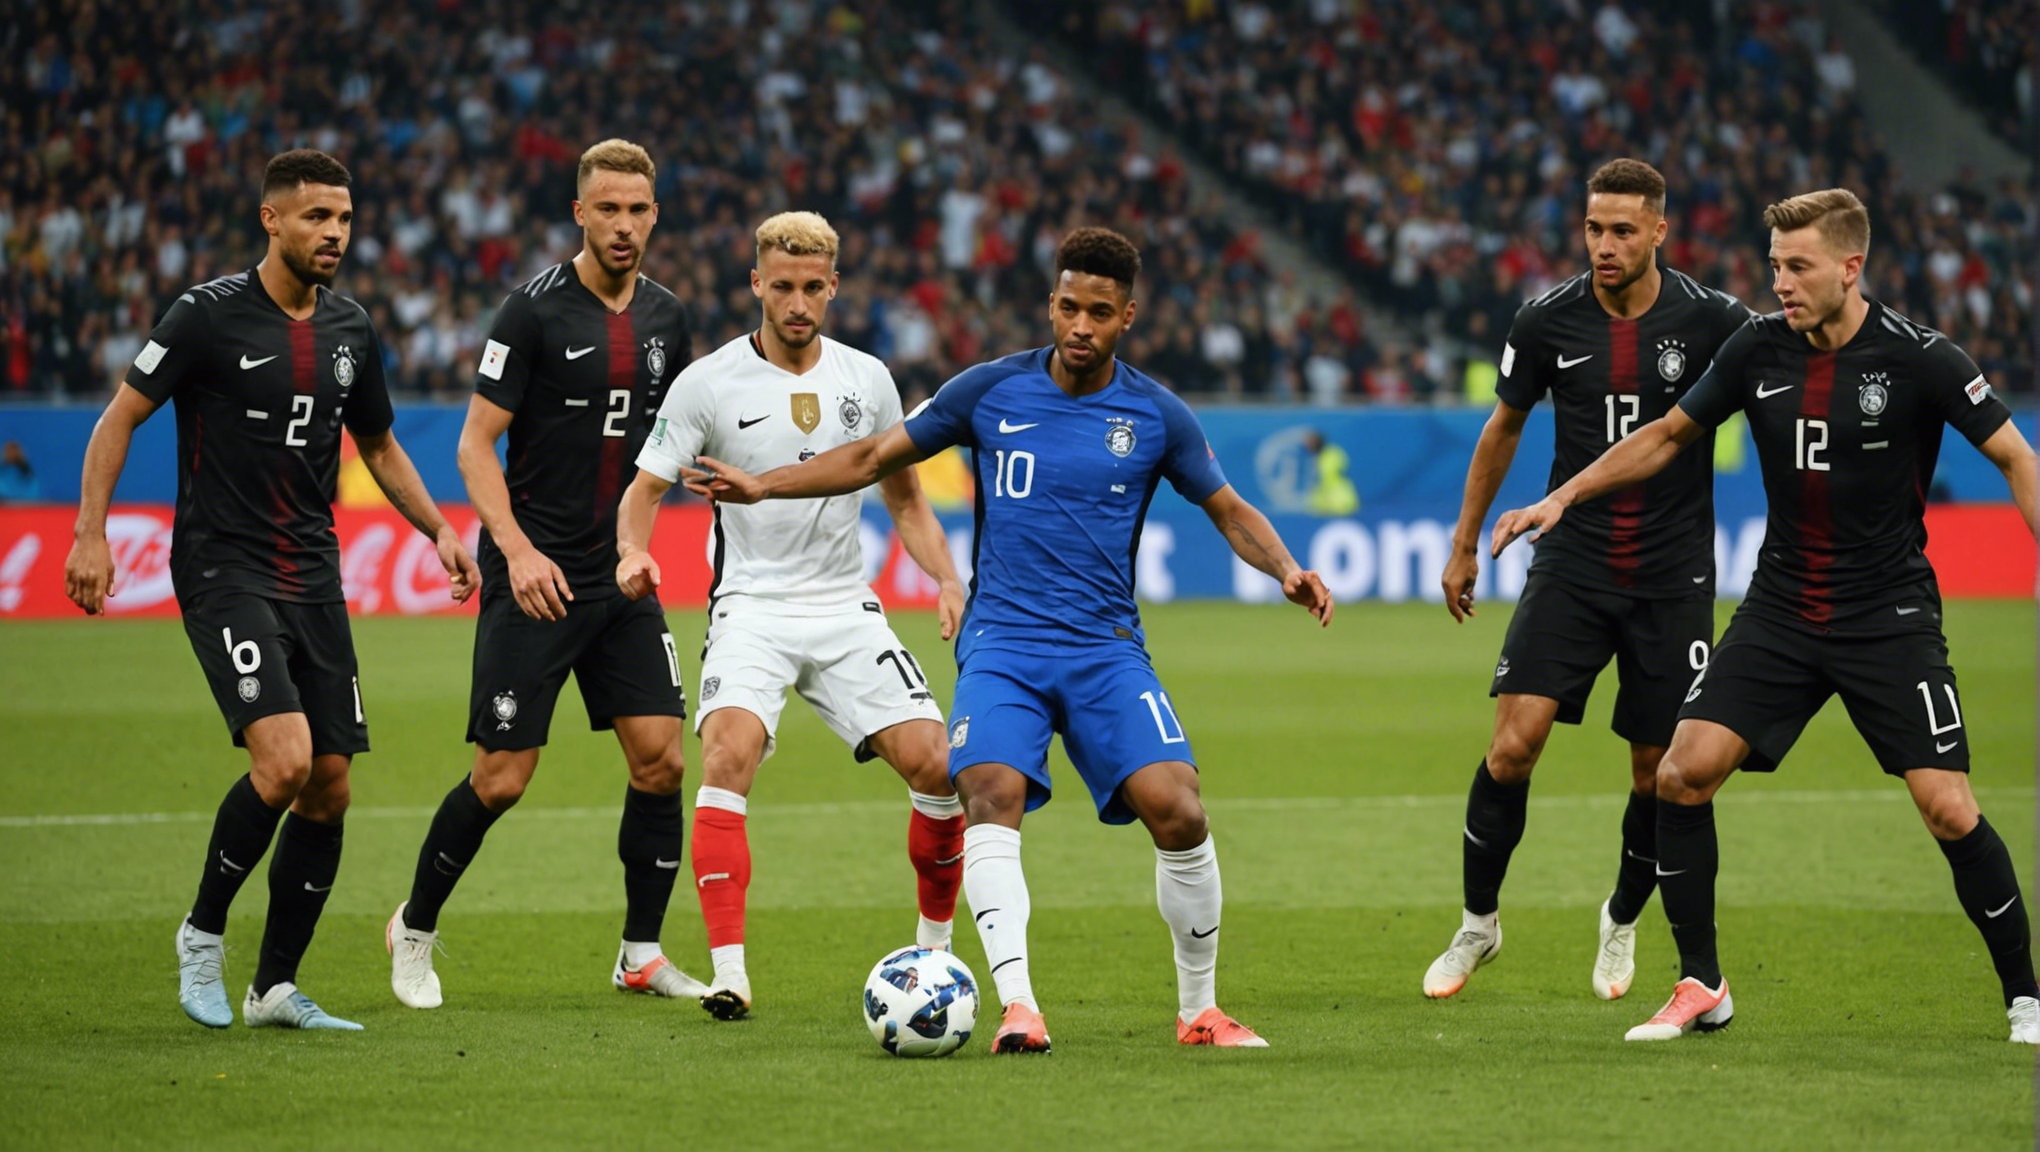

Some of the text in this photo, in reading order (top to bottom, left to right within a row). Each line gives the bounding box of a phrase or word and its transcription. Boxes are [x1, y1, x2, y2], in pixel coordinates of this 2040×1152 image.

[285, 395, 314, 447] 2
[603, 389, 631, 437] 2
[1605, 394, 1640, 443] 12
[1796, 418, 1831, 471] 12
[995, 450, 1035, 499] 10
